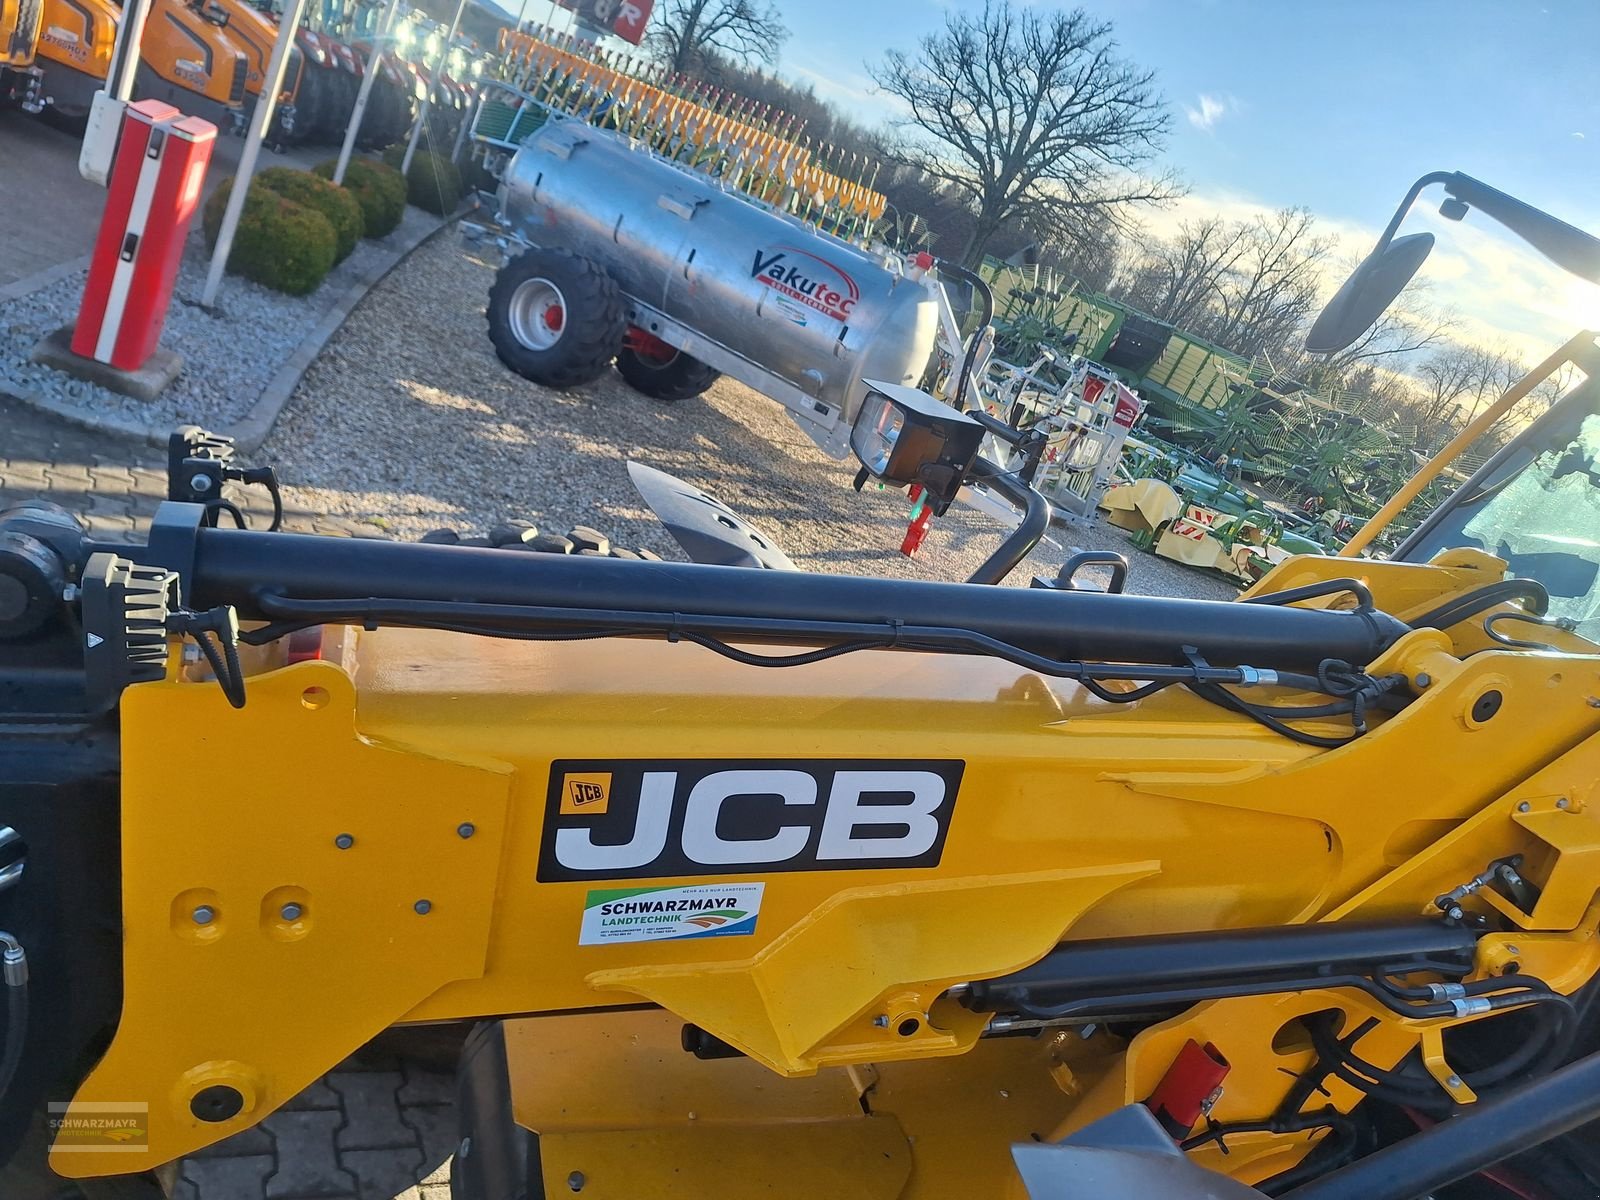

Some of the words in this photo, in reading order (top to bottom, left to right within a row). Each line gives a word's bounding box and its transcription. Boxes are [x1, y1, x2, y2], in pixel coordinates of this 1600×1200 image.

[751, 249, 856, 314] Vakutec
[575, 783, 602, 803] JCB
[555, 770, 946, 870] JCB
[601, 898, 737, 915] SCHWARZMAYR
[602, 914, 681, 926] LANDTECHNIK
